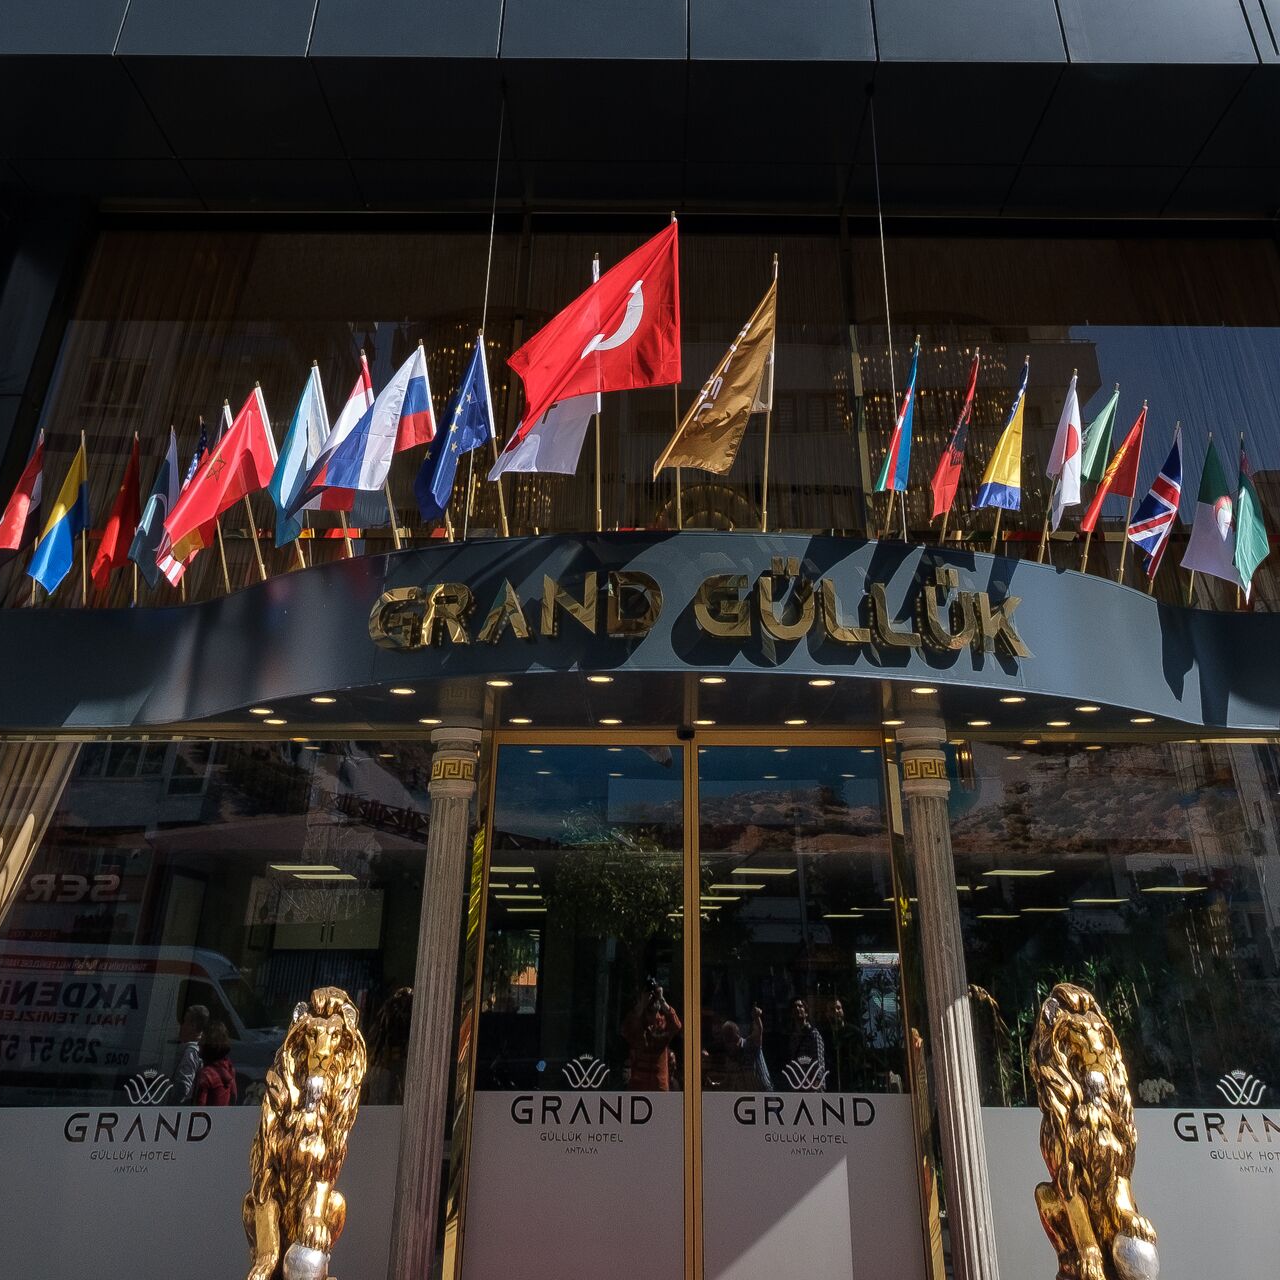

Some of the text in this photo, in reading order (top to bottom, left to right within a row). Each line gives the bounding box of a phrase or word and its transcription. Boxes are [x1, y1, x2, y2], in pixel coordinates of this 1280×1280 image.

[368, 555, 1032, 660] GRAND GÜLLÜK
[510, 1095, 653, 1126] GRAND
[732, 1096, 876, 1127] GRAND
[63, 1111, 212, 1144] GRAND
[539, 1129, 623, 1144] GÜLLÜK HOTEL
[764, 1130, 848, 1145] GÜLLÜK HOTEL
[89, 1148, 177, 1162] GÜLLÜK HOTEL
[1209, 1147, 1254, 1161] GÜLLÜK
